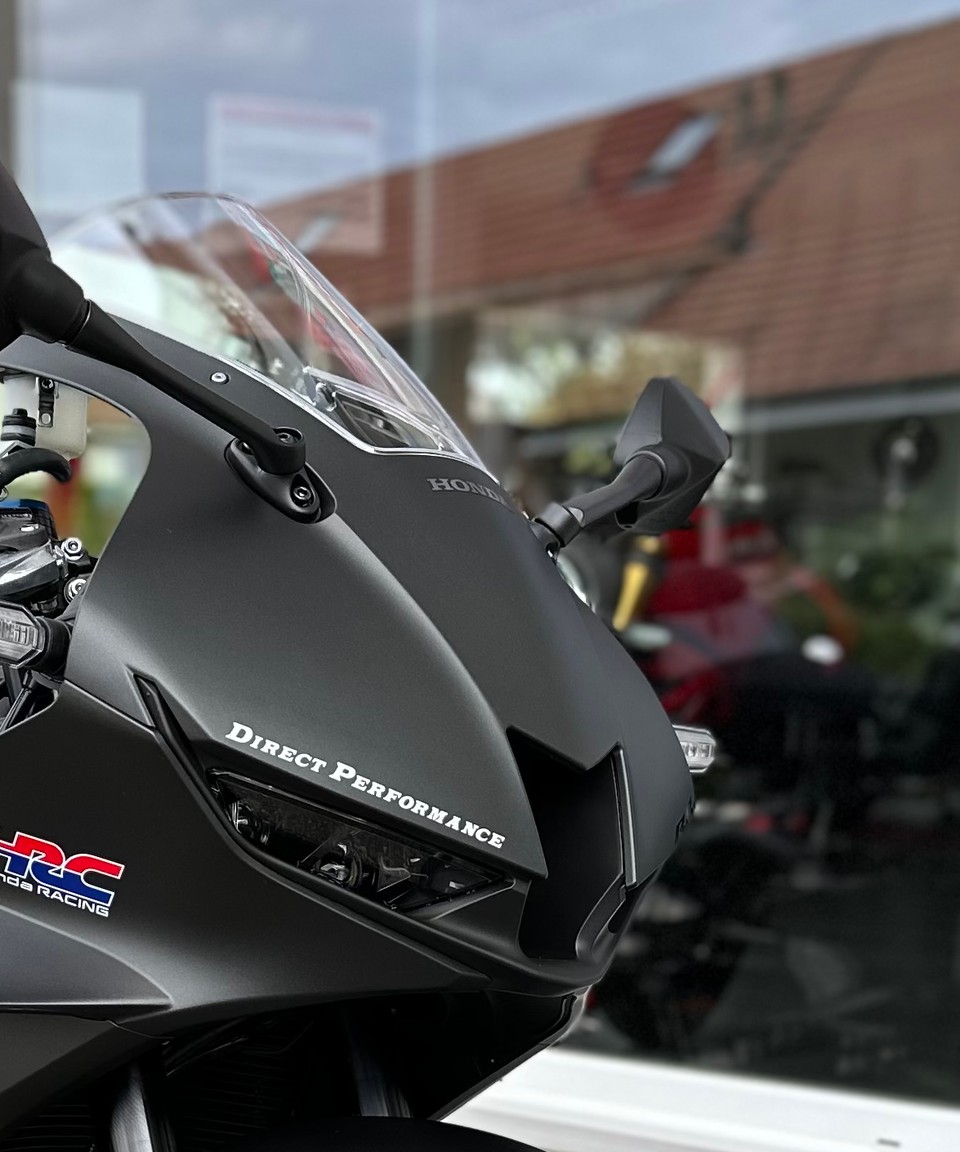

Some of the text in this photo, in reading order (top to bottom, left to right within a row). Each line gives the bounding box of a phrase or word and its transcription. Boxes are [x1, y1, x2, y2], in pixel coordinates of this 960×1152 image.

[225, 721, 506, 849] DIRECT PERFORMANCE
[37, 885, 110, 917] RACING
